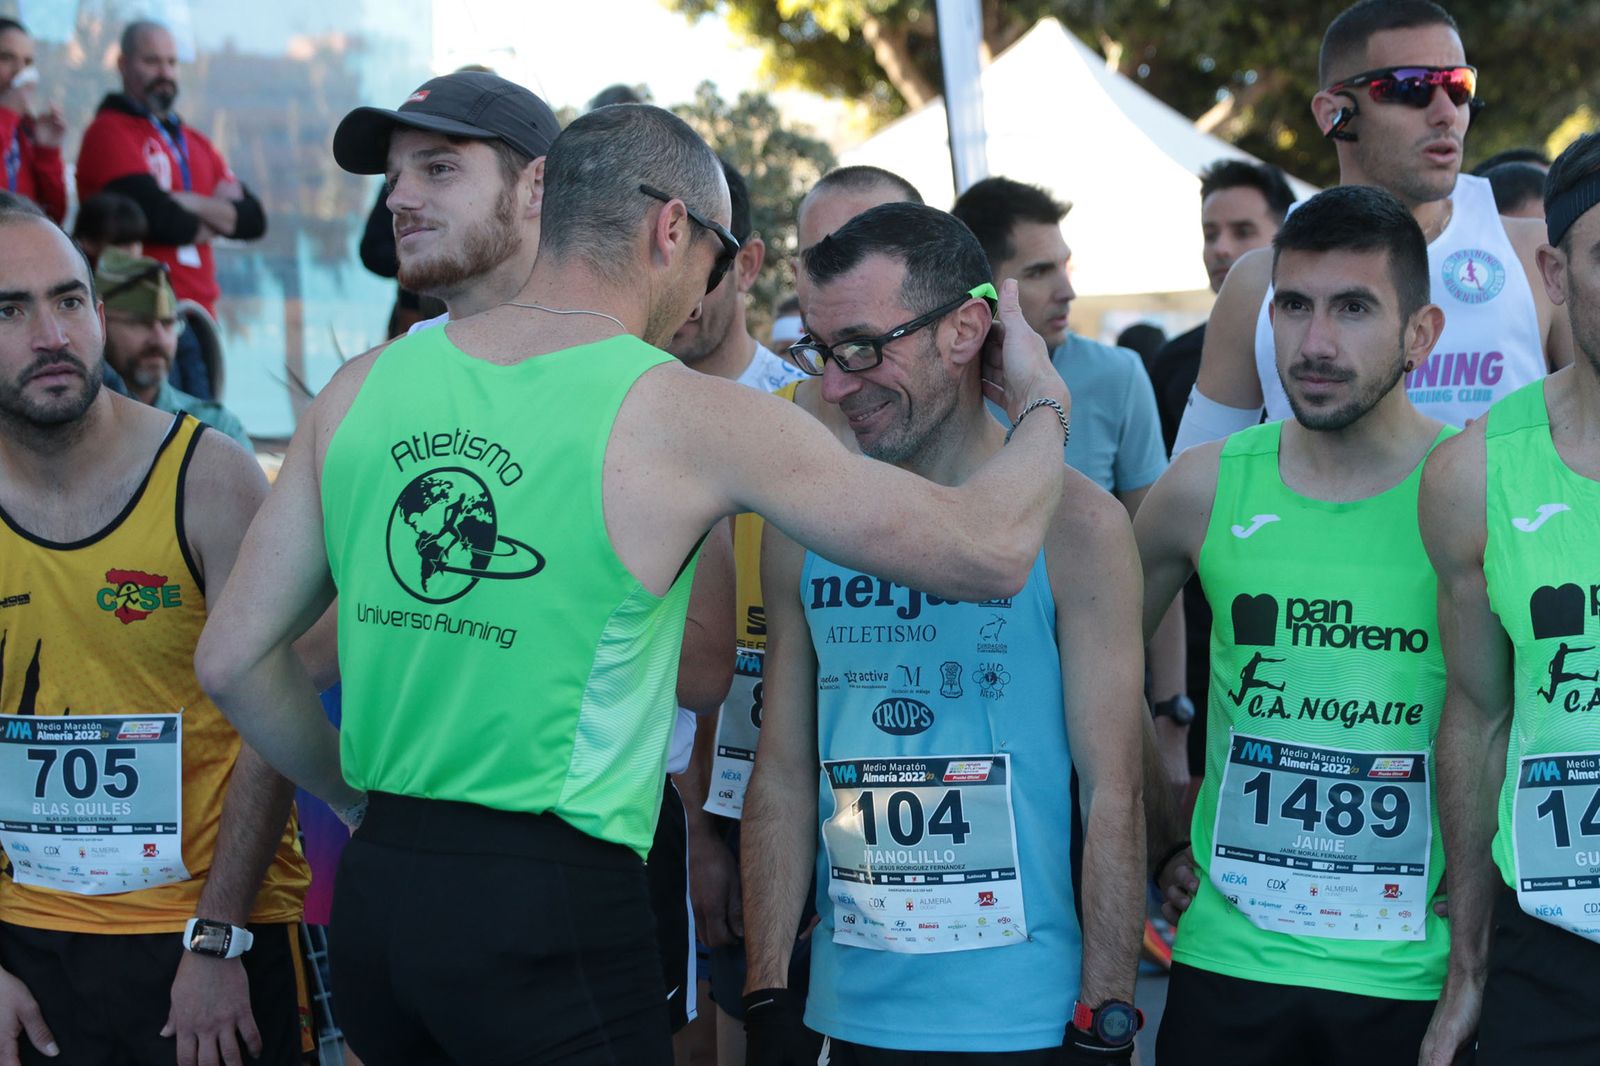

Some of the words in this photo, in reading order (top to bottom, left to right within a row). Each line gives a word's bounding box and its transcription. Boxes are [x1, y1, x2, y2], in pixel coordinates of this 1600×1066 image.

[391, 428, 523, 487] Atletismo
[810, 574, 960, 620] nerj
[1286, 598, 1353, 629] pan
[825, 624, 936, 644] ATLETISMO
[1292, 622, 1429, 653] moreno
[859, 669, 889, 681] activa
[980, 688, 1004, 700] NERJA
[874, 700, 931, 728] TROPS
[1248, 694, 1291, 719] C.A.
[1297, 697, 1424, 728] NOGALTE
[37, 722, 62, 731] Medio
[64, 721, 102, 731] Maratón
[37, 730, 73, 741] Almería
[1279, 756, 1320, 772] Almería
[1280, 747, 1309, 760] Medio
[1312, 752, 1352, 765] Maratón
[863, 763, 886, 772] Medio
[889, 762, 926, 772] Maratón
[1566, 760, 1595, 769] Medio
[27, 748, 139, 799] 705
[721, 770, 742, 781] NEXA
[862, 772, 897, 783] Almería
[32, 802, 70, 816] BLAS
[74, 802, 132, 816] QUILES
[1243, 771, 1411, 839] 1489
[851, 789, 971, 846] 104
[1292, 835, 1345, 853] JAIME
[863, 849, 955, 865] MANOLILLO
[1280, 847, 1297, 855] JAIME
[1298, 849, 1319, 858] MORAL
[1221, 873, 1248, 886] NEXA
[1267, 879, 1287, 890] CDX
[1535, 906, 1563, 917] NEXA
